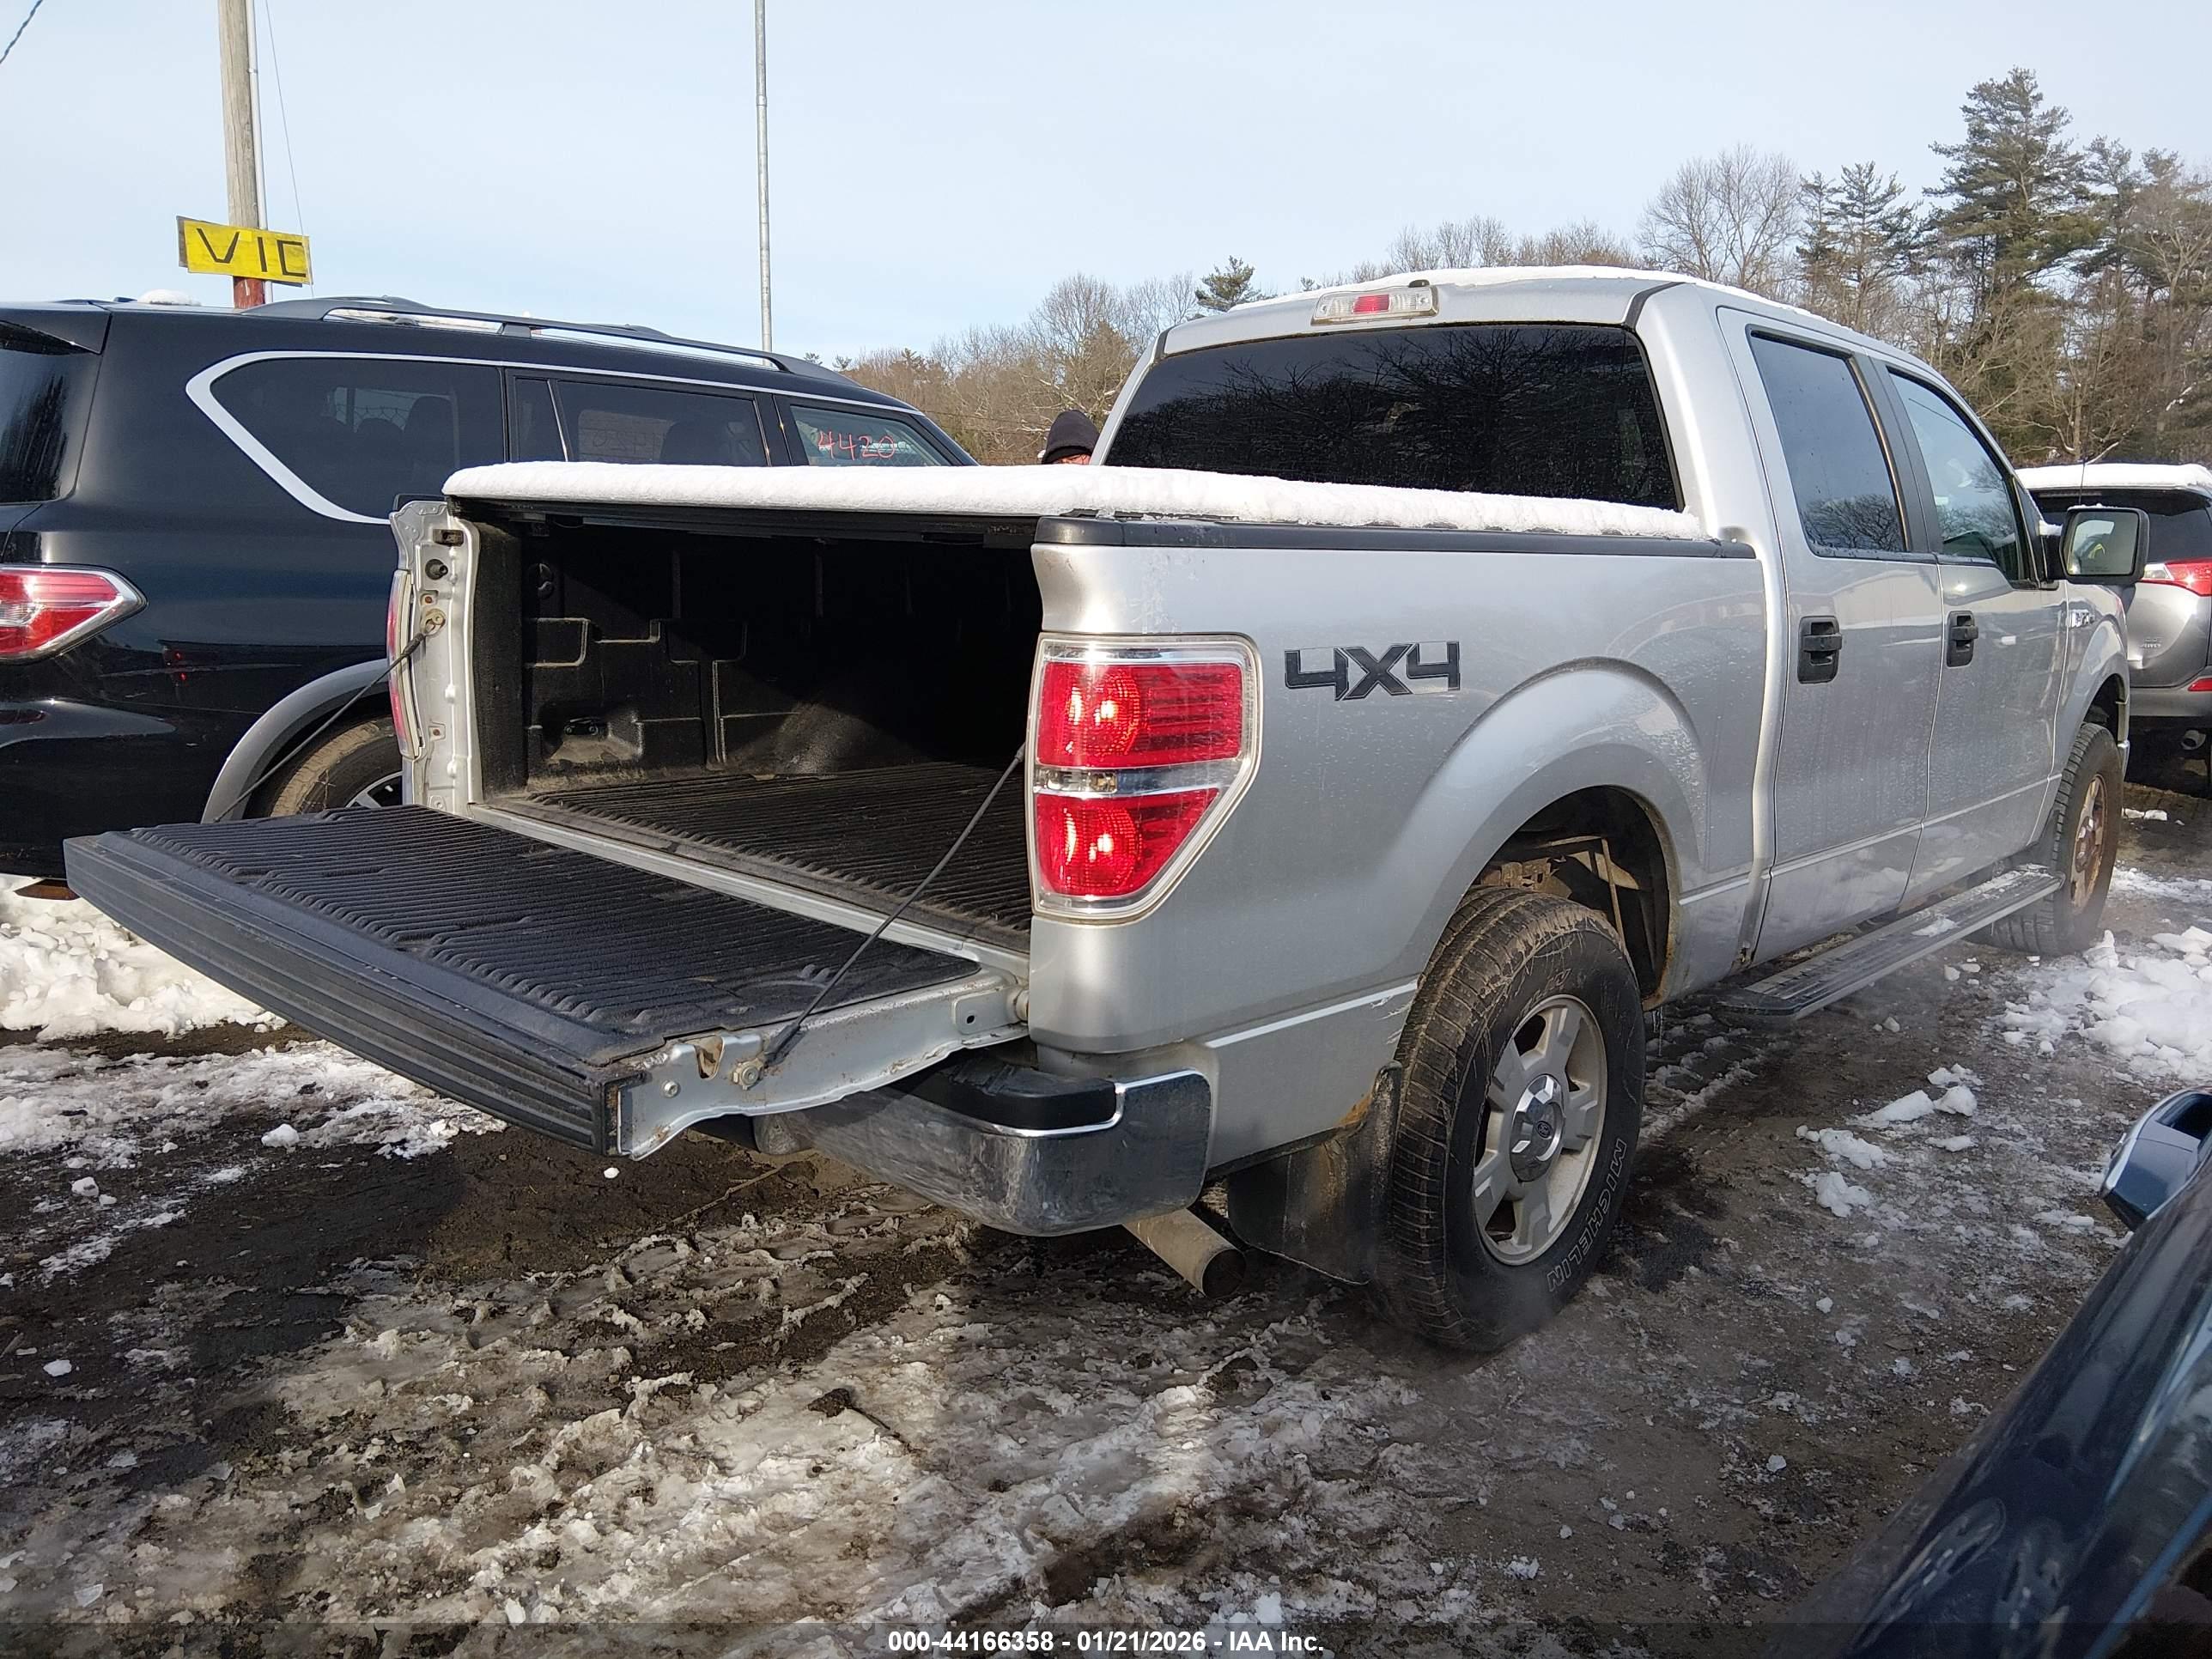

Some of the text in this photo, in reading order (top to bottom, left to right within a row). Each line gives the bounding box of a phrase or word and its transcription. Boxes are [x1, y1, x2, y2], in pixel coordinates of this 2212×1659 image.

[196, 228, 307, 278] VIC
[817, 428, 895, 461] 4420
[1546, 1138, 1627, 1292] MICHELIN
